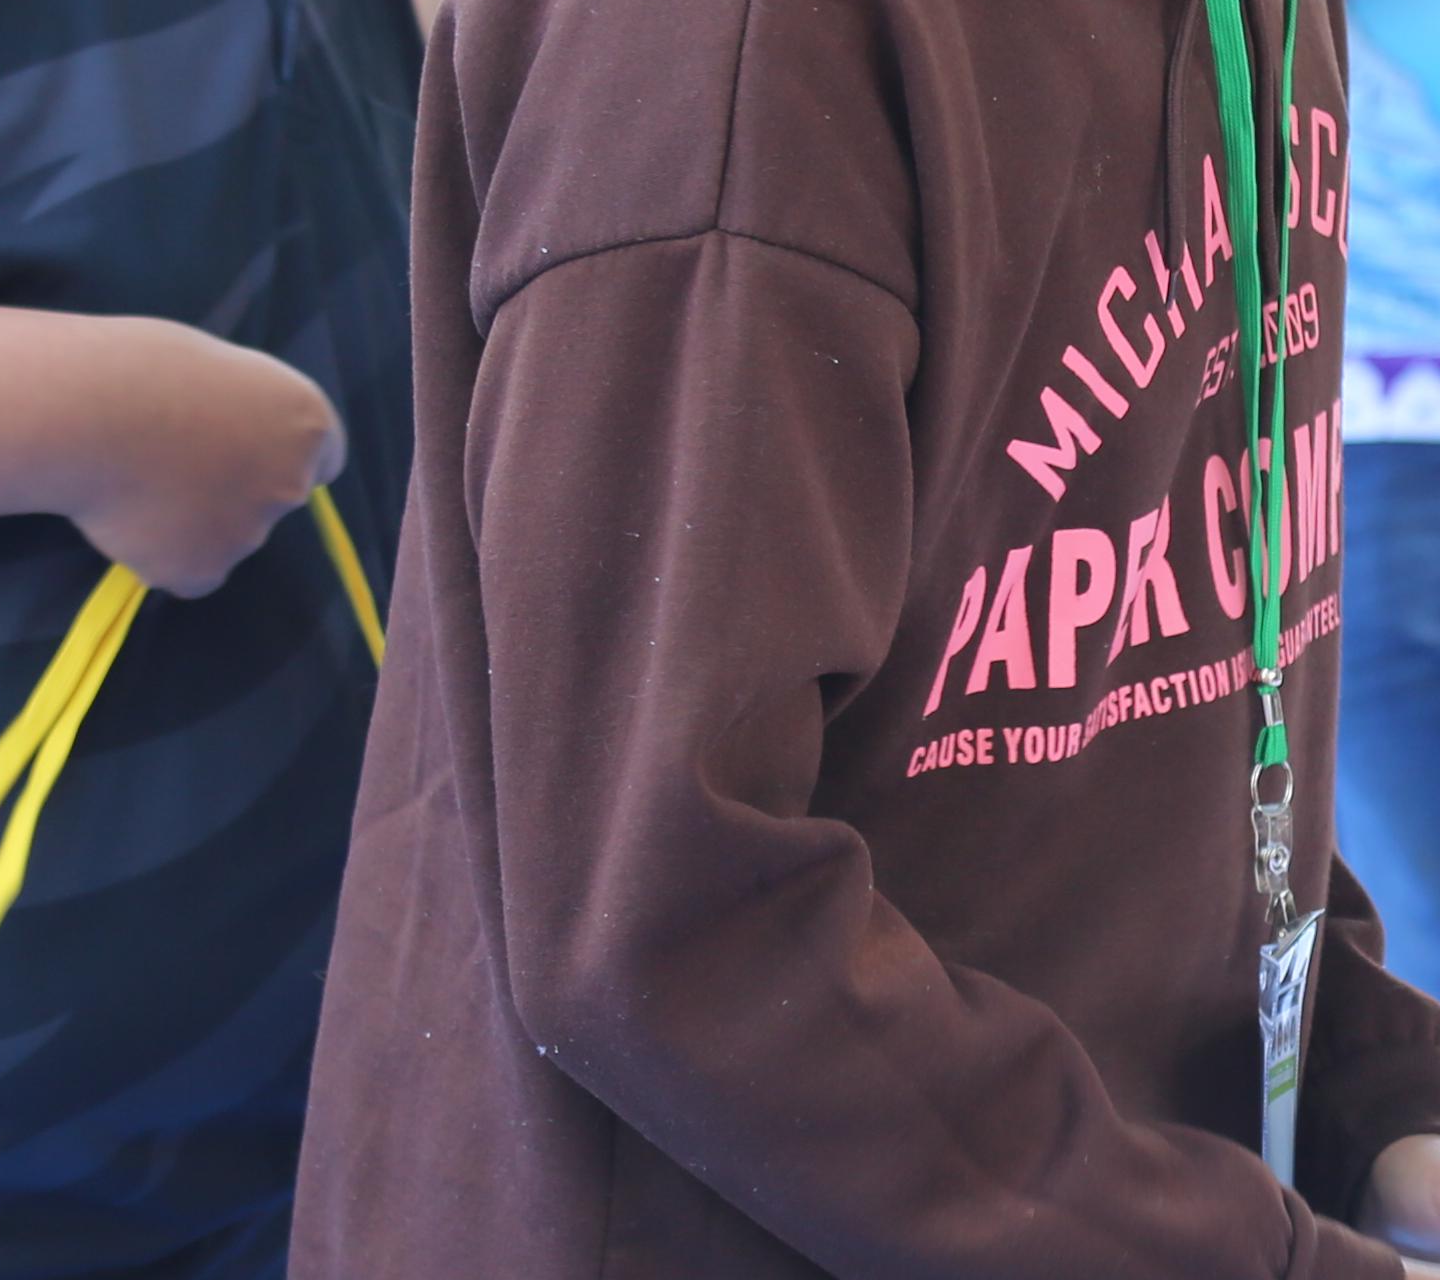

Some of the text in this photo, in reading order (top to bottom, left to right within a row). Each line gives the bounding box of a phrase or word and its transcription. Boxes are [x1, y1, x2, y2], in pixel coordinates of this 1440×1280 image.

[1007, 153, 1237, 502] MICHA
[906, 728, 994, 778] CAUSE
[1003, 721, 1081, 764] YOUR
